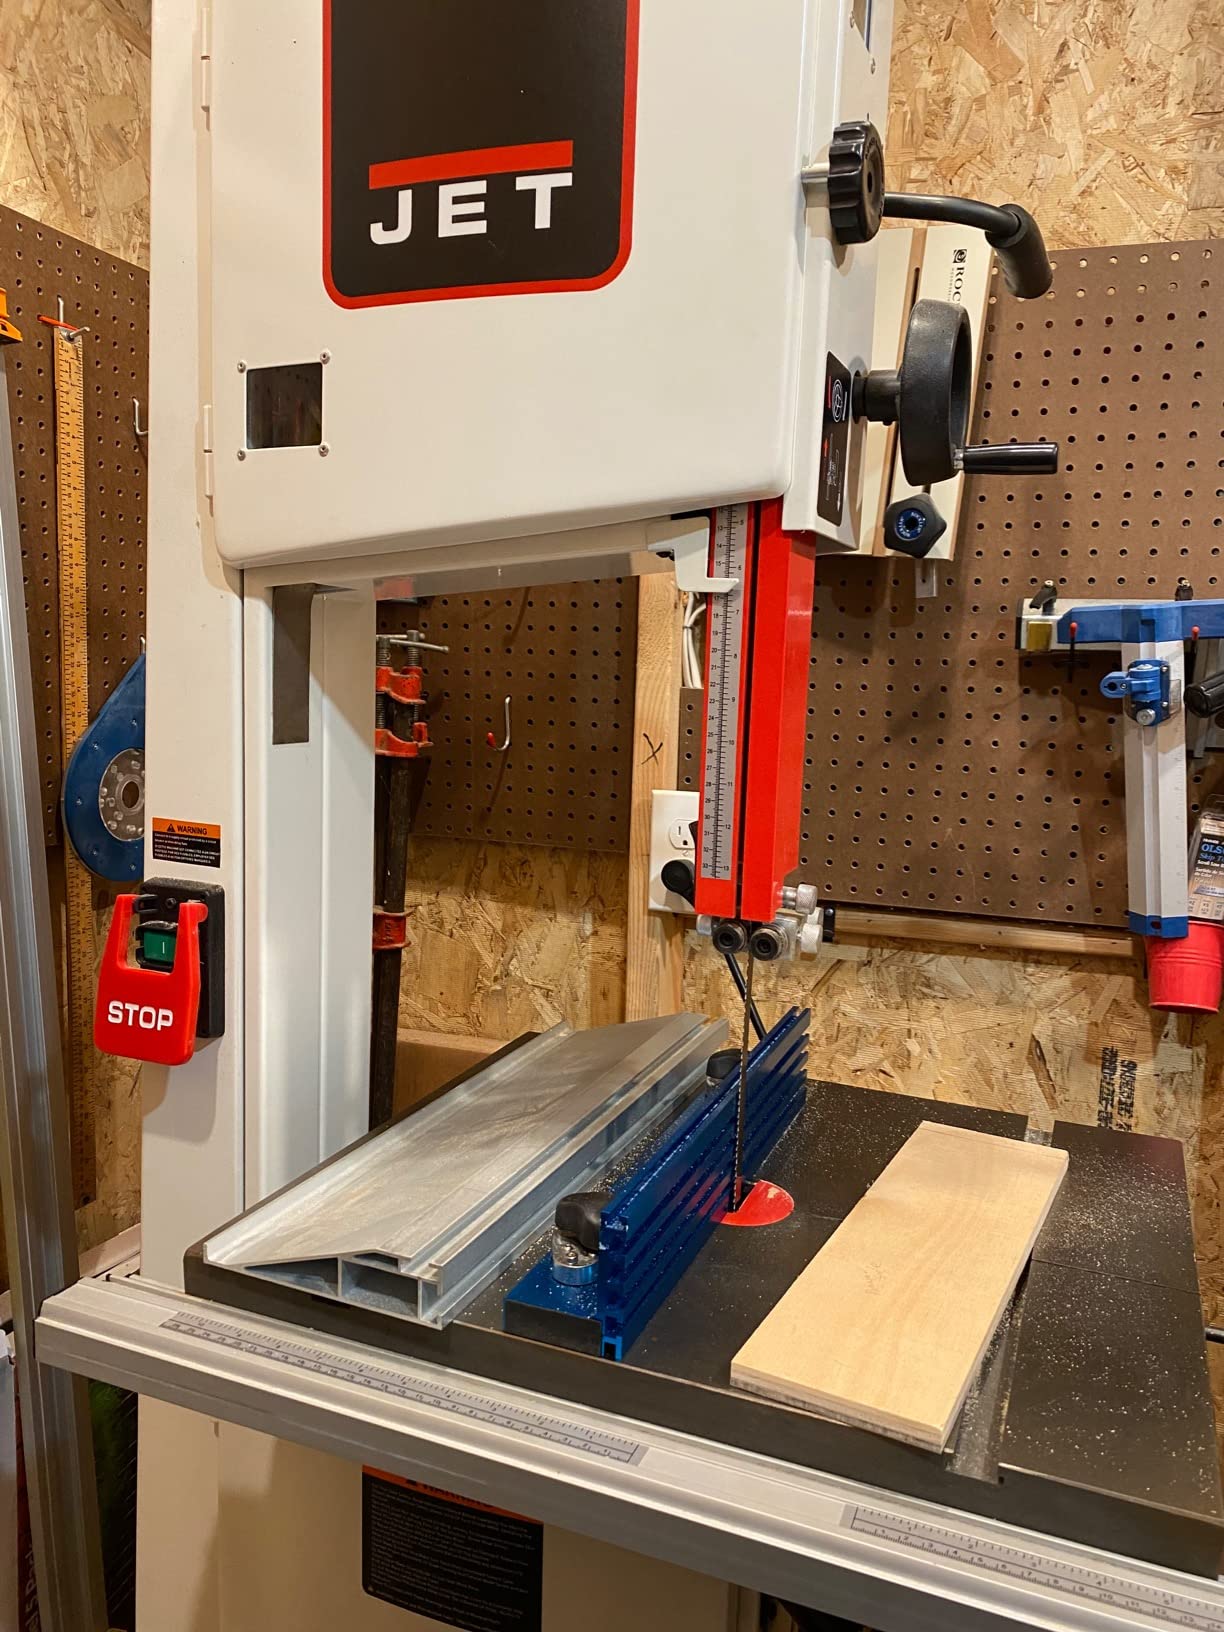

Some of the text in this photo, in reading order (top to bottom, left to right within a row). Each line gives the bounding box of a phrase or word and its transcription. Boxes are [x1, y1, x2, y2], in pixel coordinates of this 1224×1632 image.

[370, 172, 573, 245] JET
[952, 267, 965, 302] ROC
[177, 824, 207, 835] WARNING
[1202, 844, 1224, 854] OLS
[108, 1000, 174, 1031] STOP
